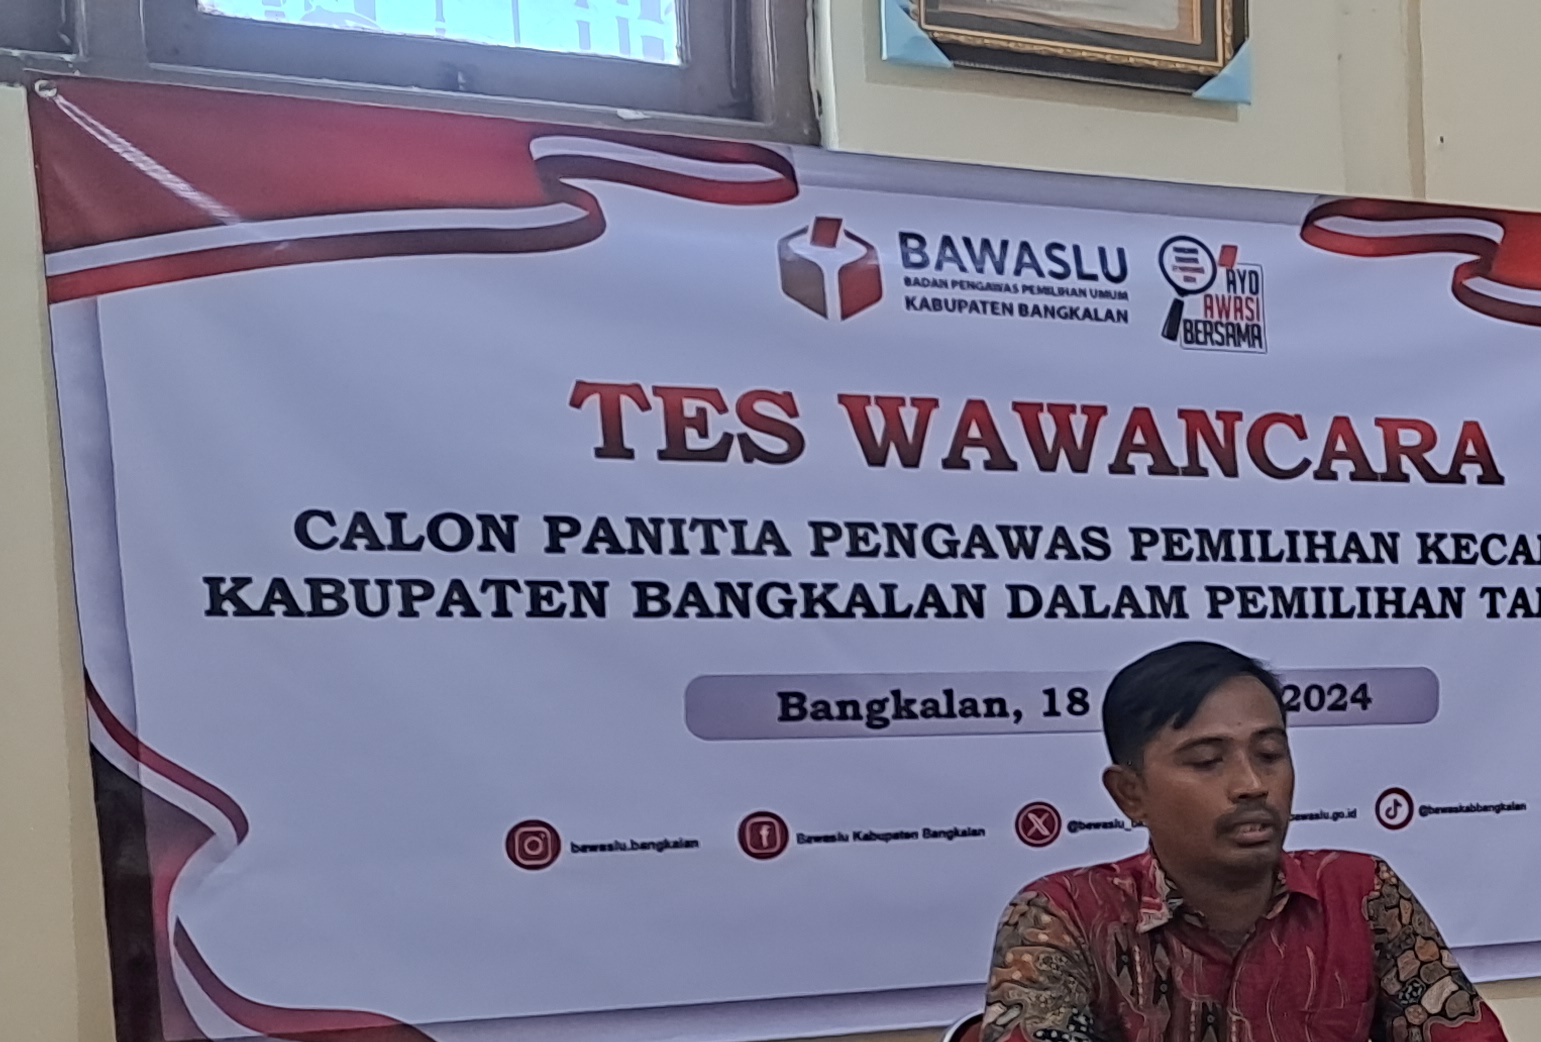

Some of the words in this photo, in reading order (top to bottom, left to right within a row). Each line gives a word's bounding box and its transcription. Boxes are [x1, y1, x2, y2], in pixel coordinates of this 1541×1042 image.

[898, 231, 1128, 284] BAWASLU
[904, 276, 949, 289] BADAN
[951, 279, 1019, 294] PENGAWAS
[1226, 268, 1260, 296] AYO
[904, 296, 1014, 317] KABUPATEN
[1018, 302, 1129, 324] BANGKALAN
[1203, 293, 1261, 323] AWASI
[1182, 319, 1263, 349] BERSAMA
[569, 380, 806, 465] TES
[837, 393, 1505, 486] WAWANCARA
[293, 509, 519, 554] CALON
[543, 515, 791, 557] PANITIA
[808, 520, 1112, 562] PENGAWAS
[1128, 526, 1400, 565] PEMILIHAN
[202, 576, 610, 619] KABUPATEN
[630, 580, 987, 620] BANGKALAN
[1005, 584, 1190, 620] DALAM
[1204, 585, 1466, 620] PEMILIHAN
[776, 688, 1023, 730] Bangkalan,
[1042, 687, 1090, 718] 18
[1282, 682, 1373, 713] 2024
[852, 830, 919, 843] Kabupaten
[922, 827, 986, 841] Bangkalan
